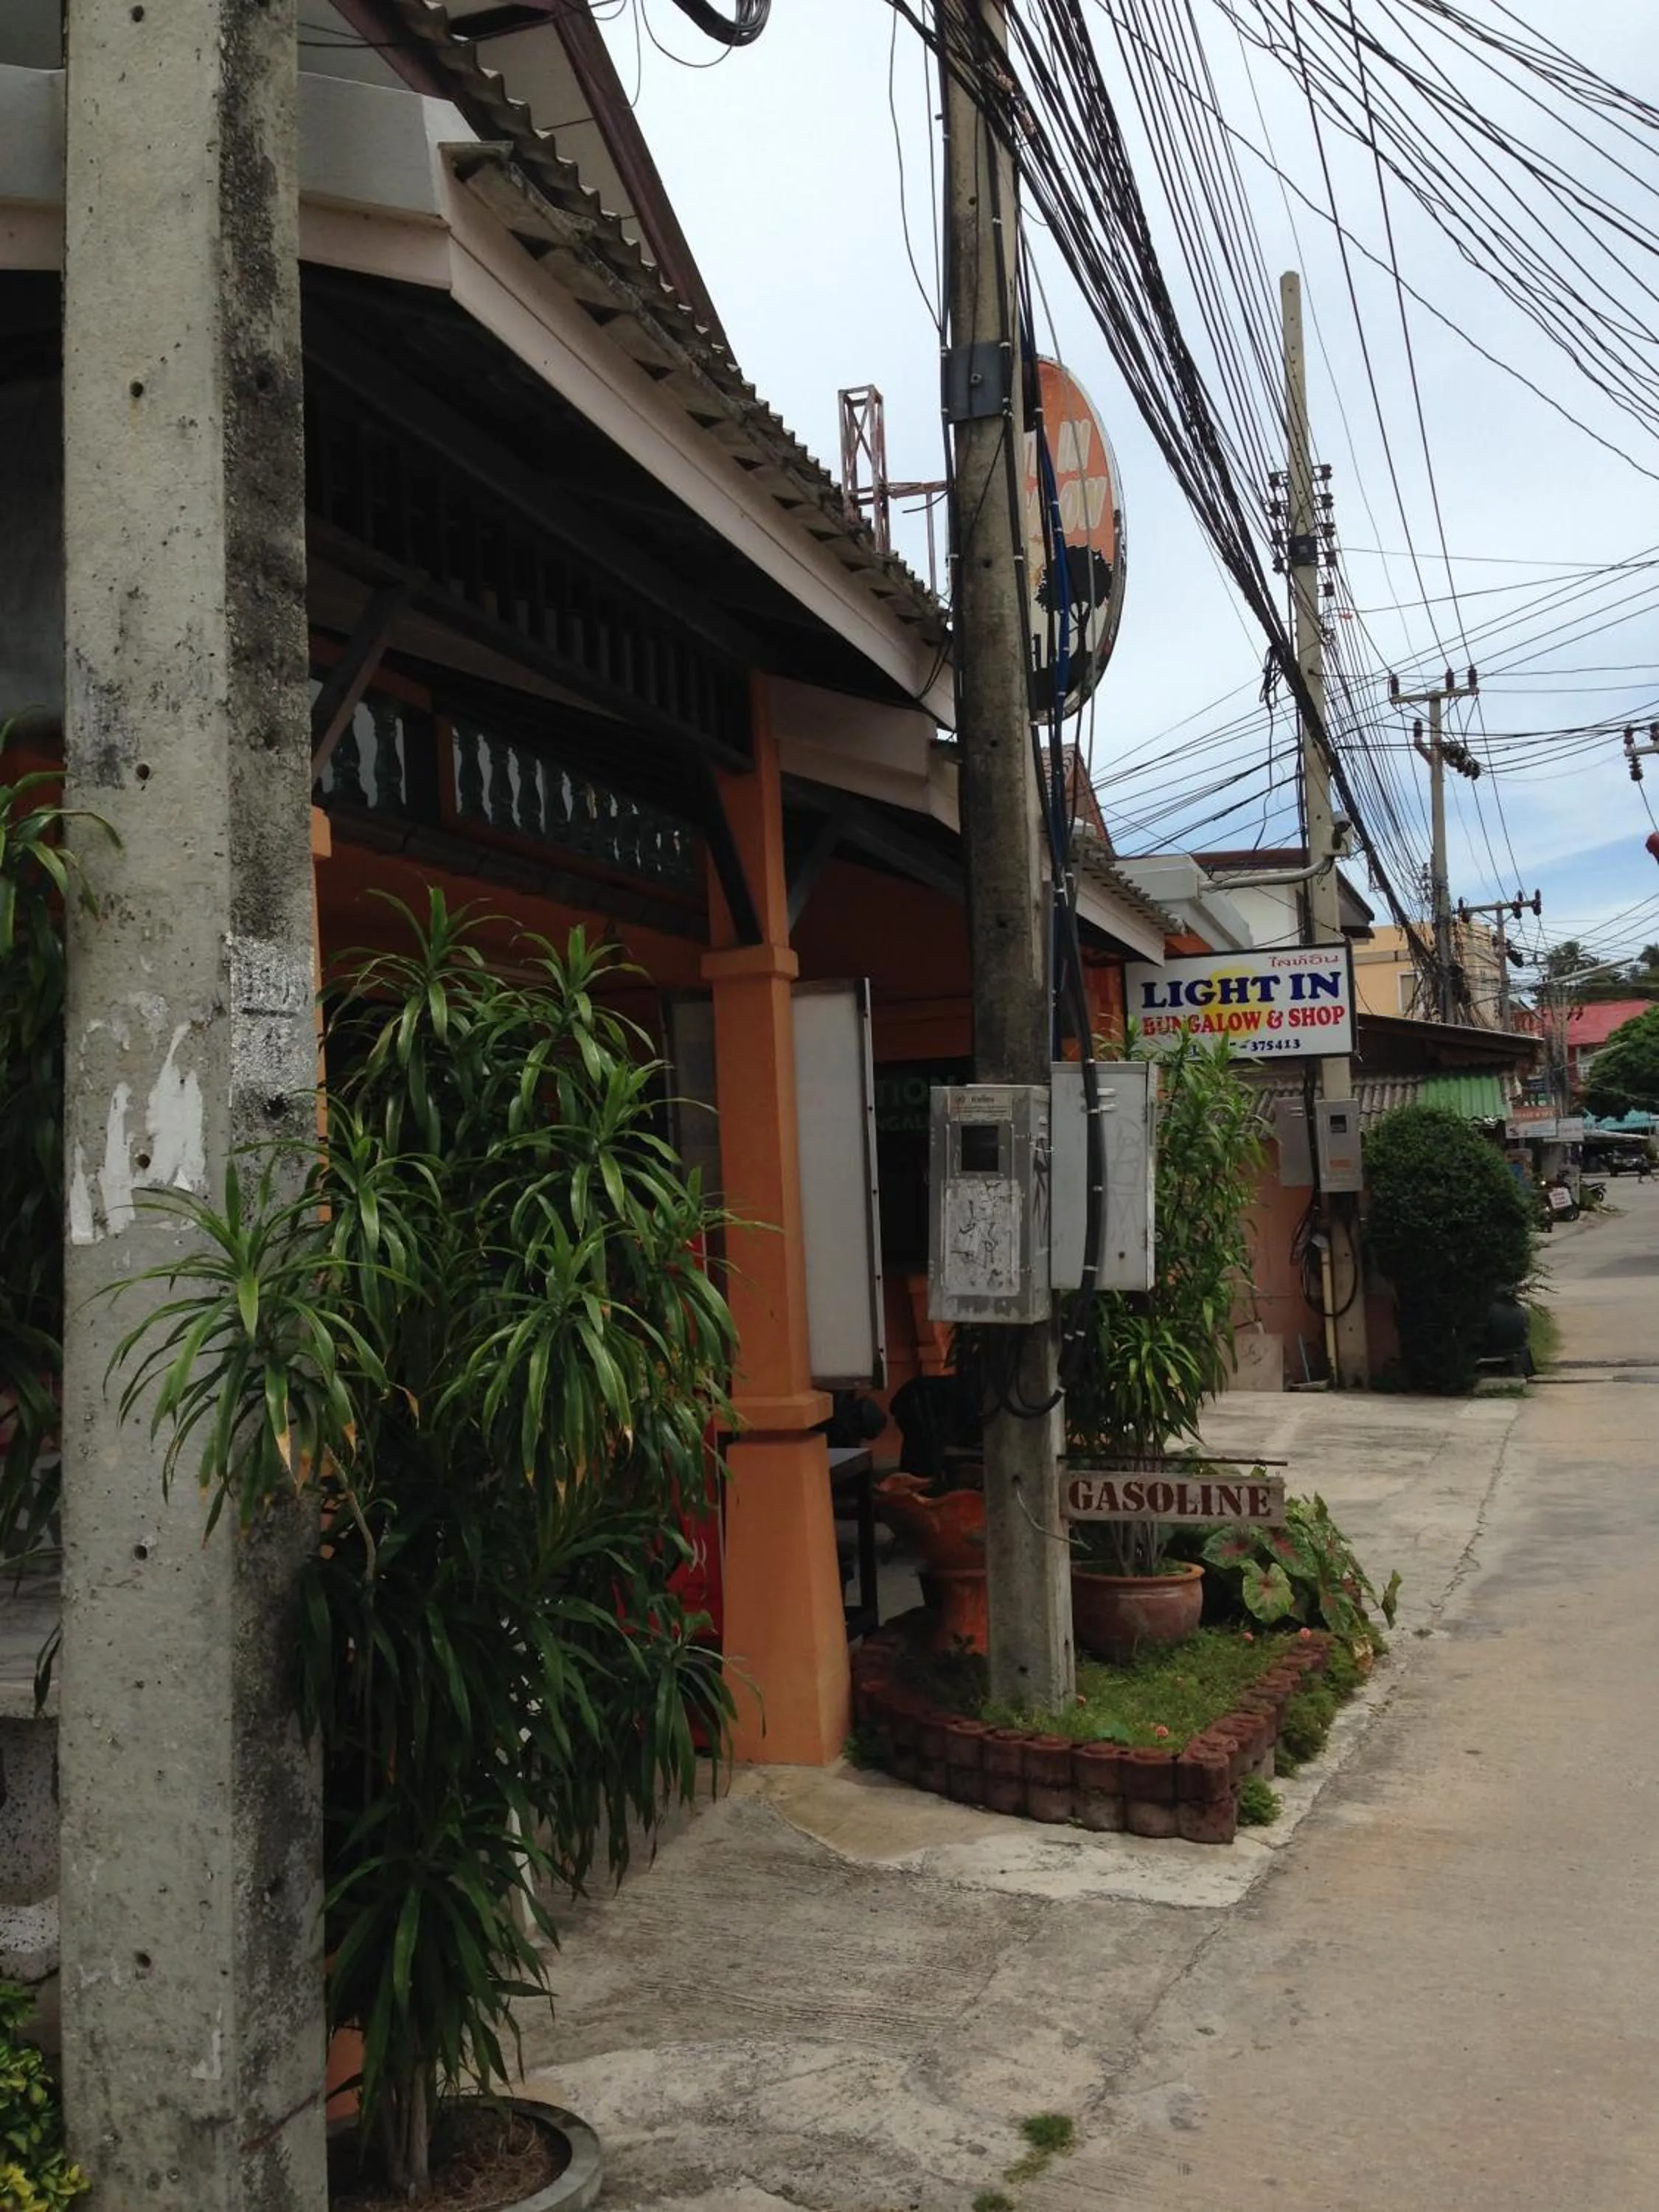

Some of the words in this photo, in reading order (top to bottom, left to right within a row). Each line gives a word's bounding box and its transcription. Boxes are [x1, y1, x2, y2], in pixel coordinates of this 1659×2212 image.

[1141, 975, 1280, 1009] LIGHT
[1289, 971, 1341, 1001] IN
[1142, 1011, 1262, 1037] BUNGALOW
[1266, 1010, 1284, 1030] &
[1288, 1006, 1346, 1028] SHOP
[1069, 1479, 1272, 1517] GASOLINE
